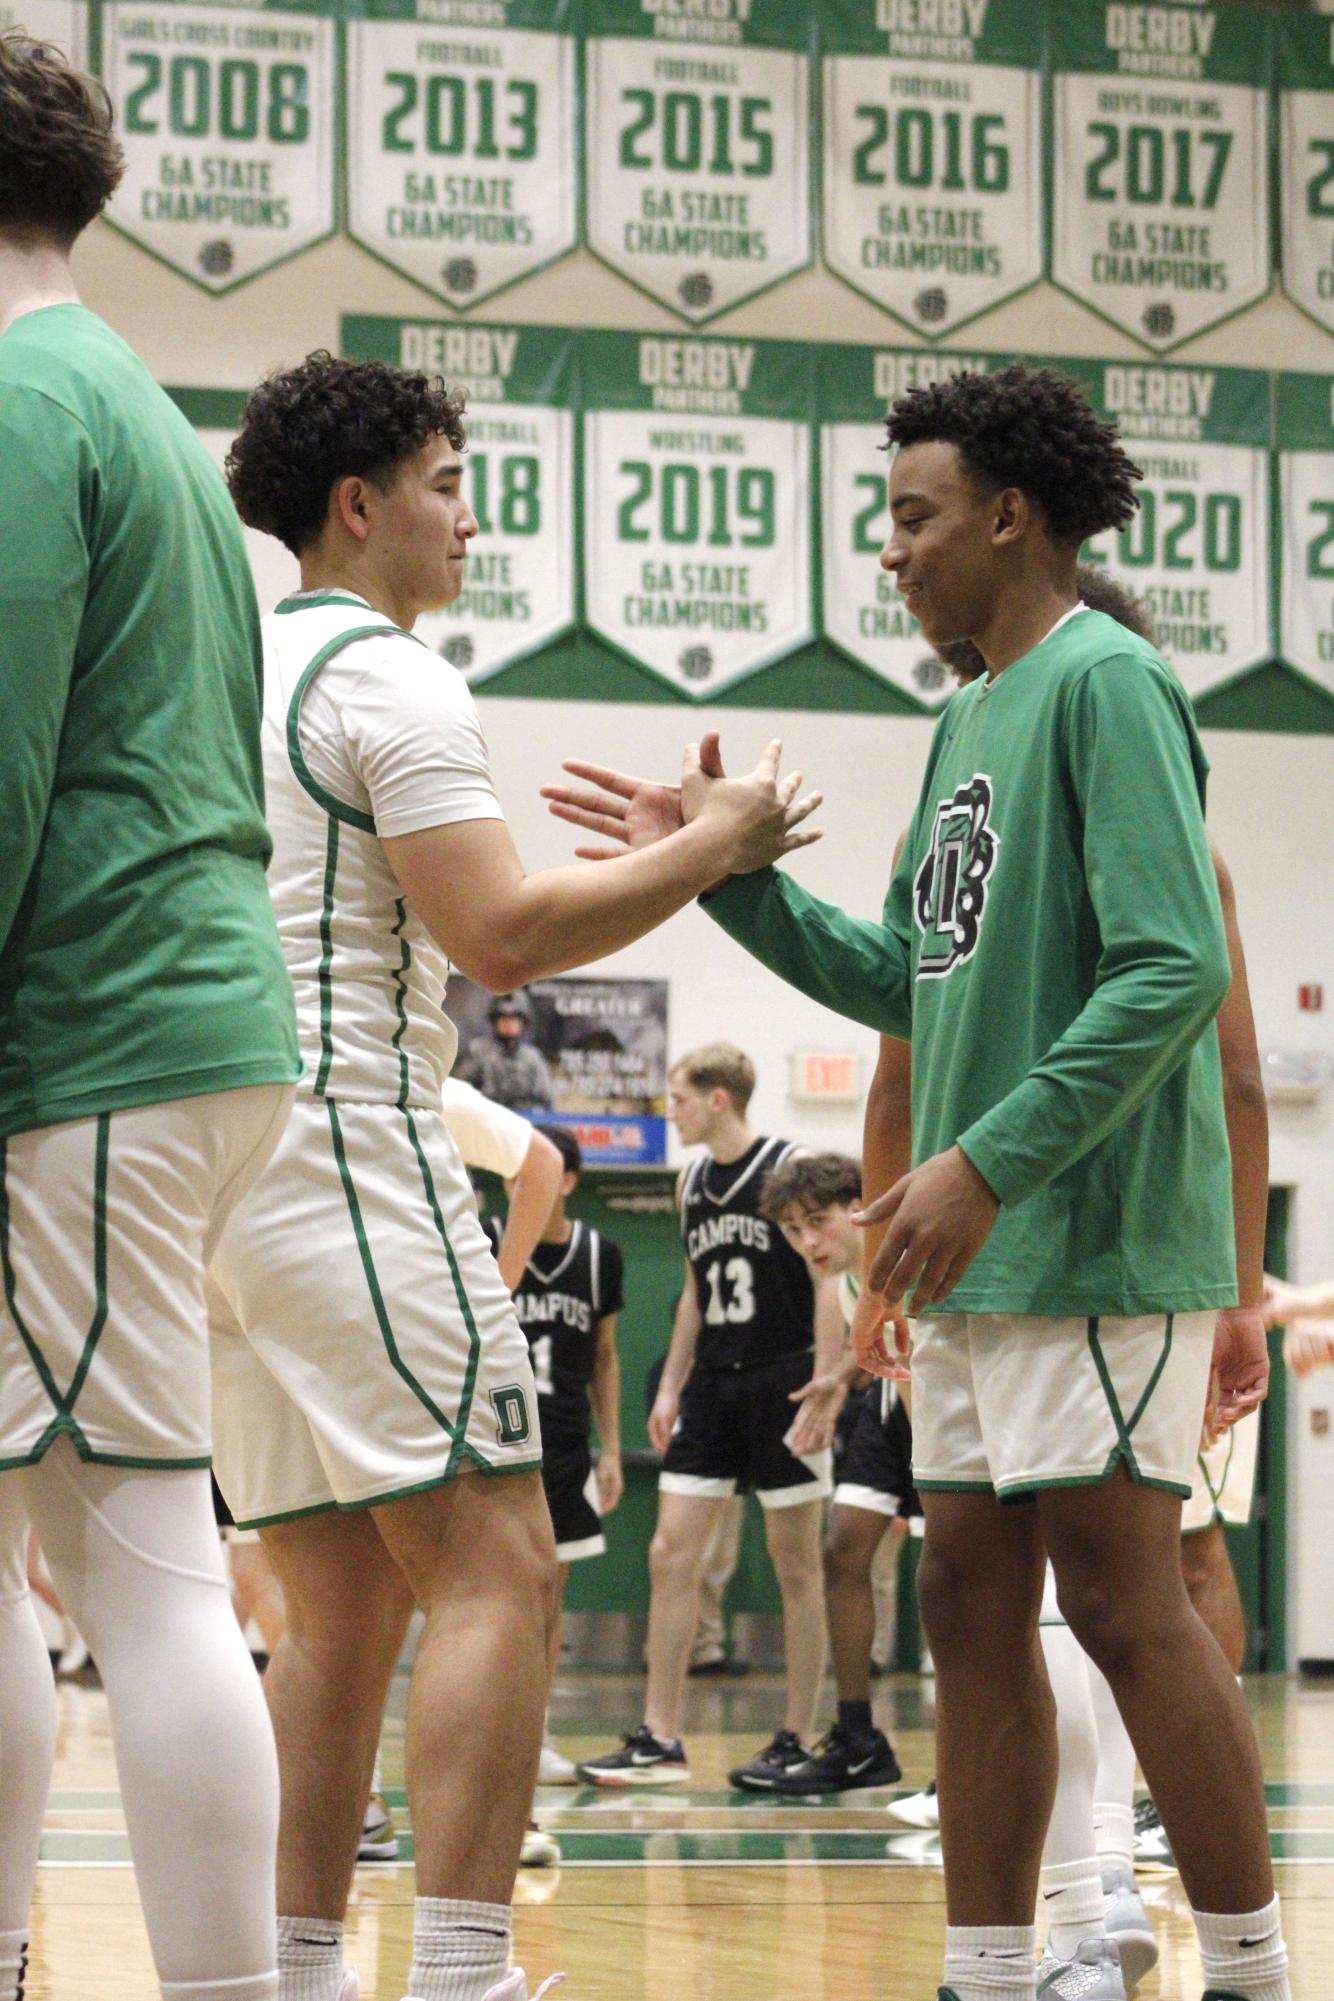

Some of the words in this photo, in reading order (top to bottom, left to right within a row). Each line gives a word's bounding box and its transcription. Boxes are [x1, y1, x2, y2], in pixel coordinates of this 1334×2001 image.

[1105, 4, 1216, 56] DERBY
[416, 40, 502, 67] FOOTBALL
[654, 57, 738, 84] FOOTBALL
[125, 52, 309, 144] 2008
[891, 74, 971, 102] FOOTBALL
[383, 70, 538, 160] 2013
[620, 88, 773, 177] 2015
[854, 105, 1009, 192] 2016
[1086, 122, 1233, 209] 2017
[160, 153, 193, 185] 6A
[202, 157, 272, 193] STATE
[404, 171, 436, 202] 6A
[444, 175, 513, 209] STATE
[142, 189, 290, 230] CHAMPIONS
[386, 207, 533, 245] CHAMPIONS
[641, 189, 672, 219] 6A
[681, 191, 748, 226] STATE
[879, 204, 909, 234] 6A
[916, 207, 982, 240] STATE
[624, 222, 767, 261] CHAMPIONS
[862, 237, 1002, 276] CHAMPIONS
[1108, 219, 1137, 250] 6A
[1145, 223, 1210, 256] STATE
[1091, 252, 1227, 292] CHAMPIONS
[401, 325, 518, 377] DERBY
[639, 338, 754, 390] DERBY
[1104, 366, 1216, 417] DERBY
[648, 430, 745, 456] WRESTLING
[470, 453, 540, 535] 18
[618, 461, 775, 547] 2019
[464, 553, 512, 585] TATE
[642, 561, 673, 592] 6A
[681, 563, 750, 597] STATE
[624, 594, 768, 634] CHAMPIONS
[1144, 586, 1209, 618] STATE
[1157, 622, 1227, 654] PIONS
[805, 1056, 851, 1092] EXIT
[688, 1213, 771, 1261] CAMPUS
[706, 1257, 755, 1325] 13
[514, 1292, 592, 1333] AMPUS
[489, 1383, 531, 1448] D
